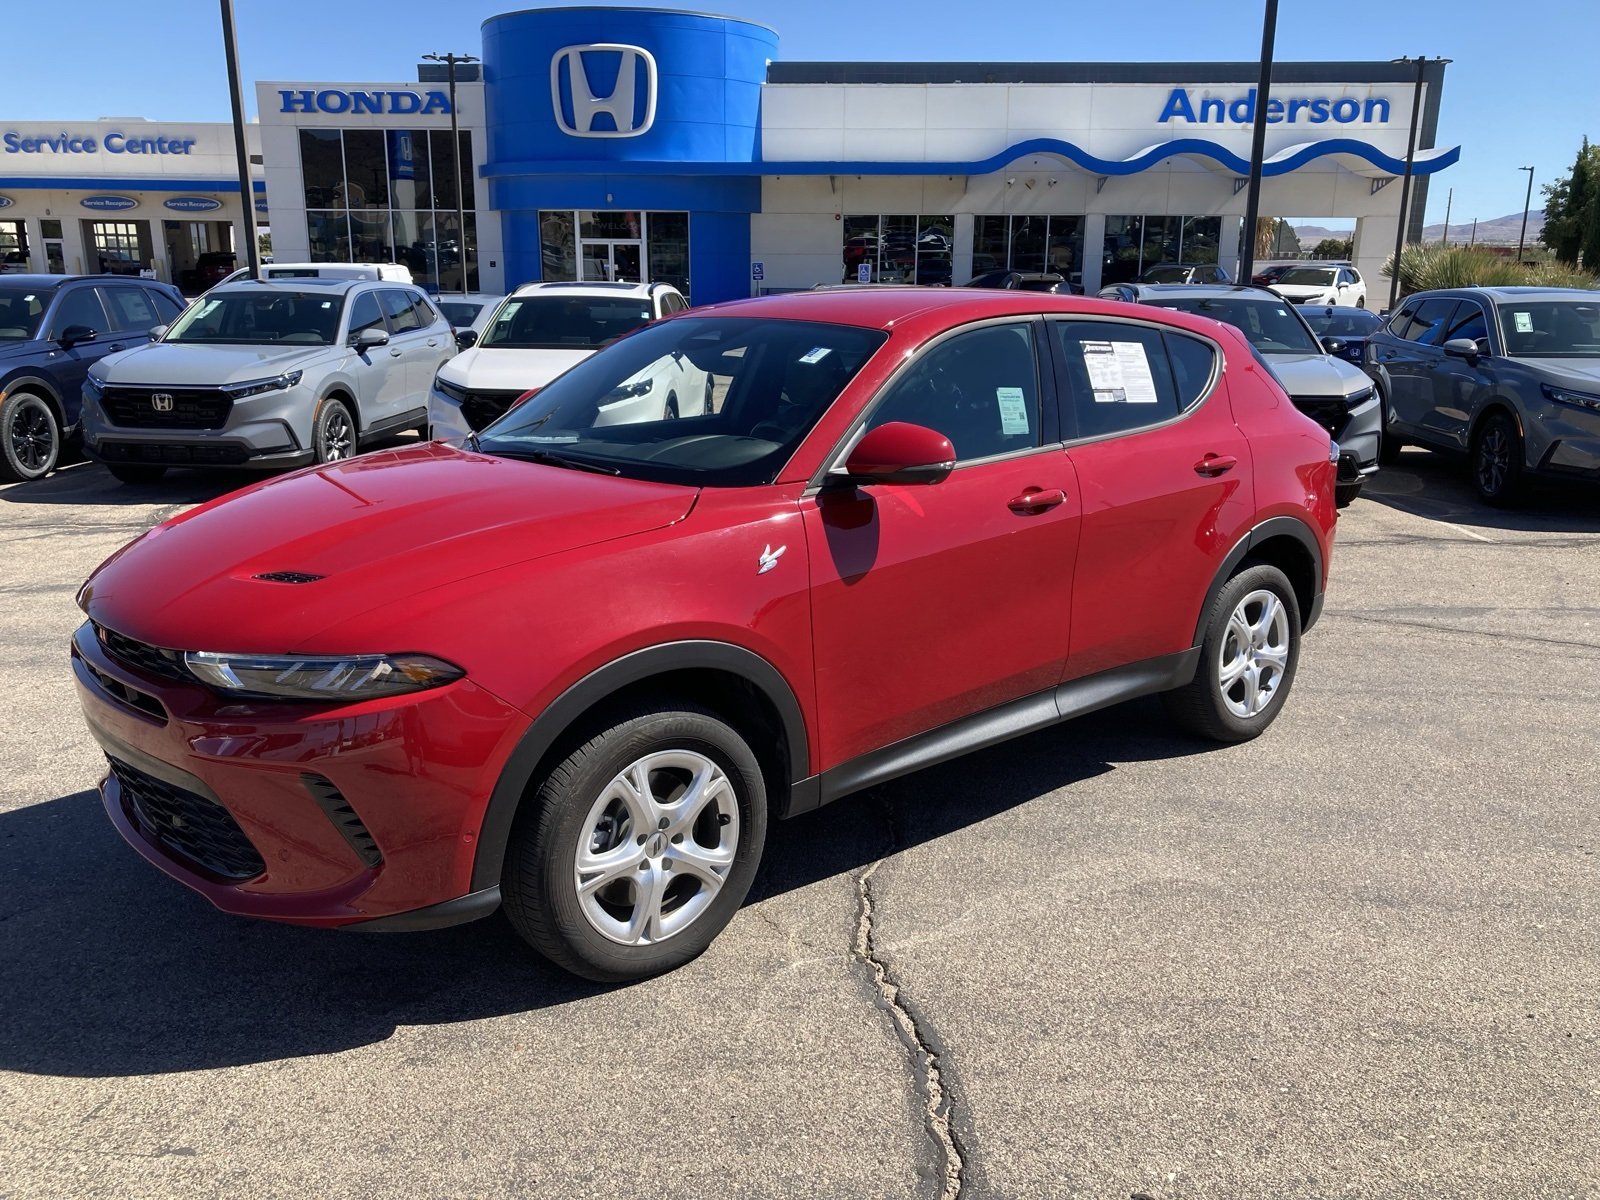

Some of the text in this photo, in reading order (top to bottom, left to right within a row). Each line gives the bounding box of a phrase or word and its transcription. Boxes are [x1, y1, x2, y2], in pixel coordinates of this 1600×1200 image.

[278, 89, 459, 114] HONDA
[1158, 88, 1391, 124] Anderson
[3, 132, 195, 155] Service Center
[105, 199, 134, 207] Reception
[188, 200, 218, 208] Reception
